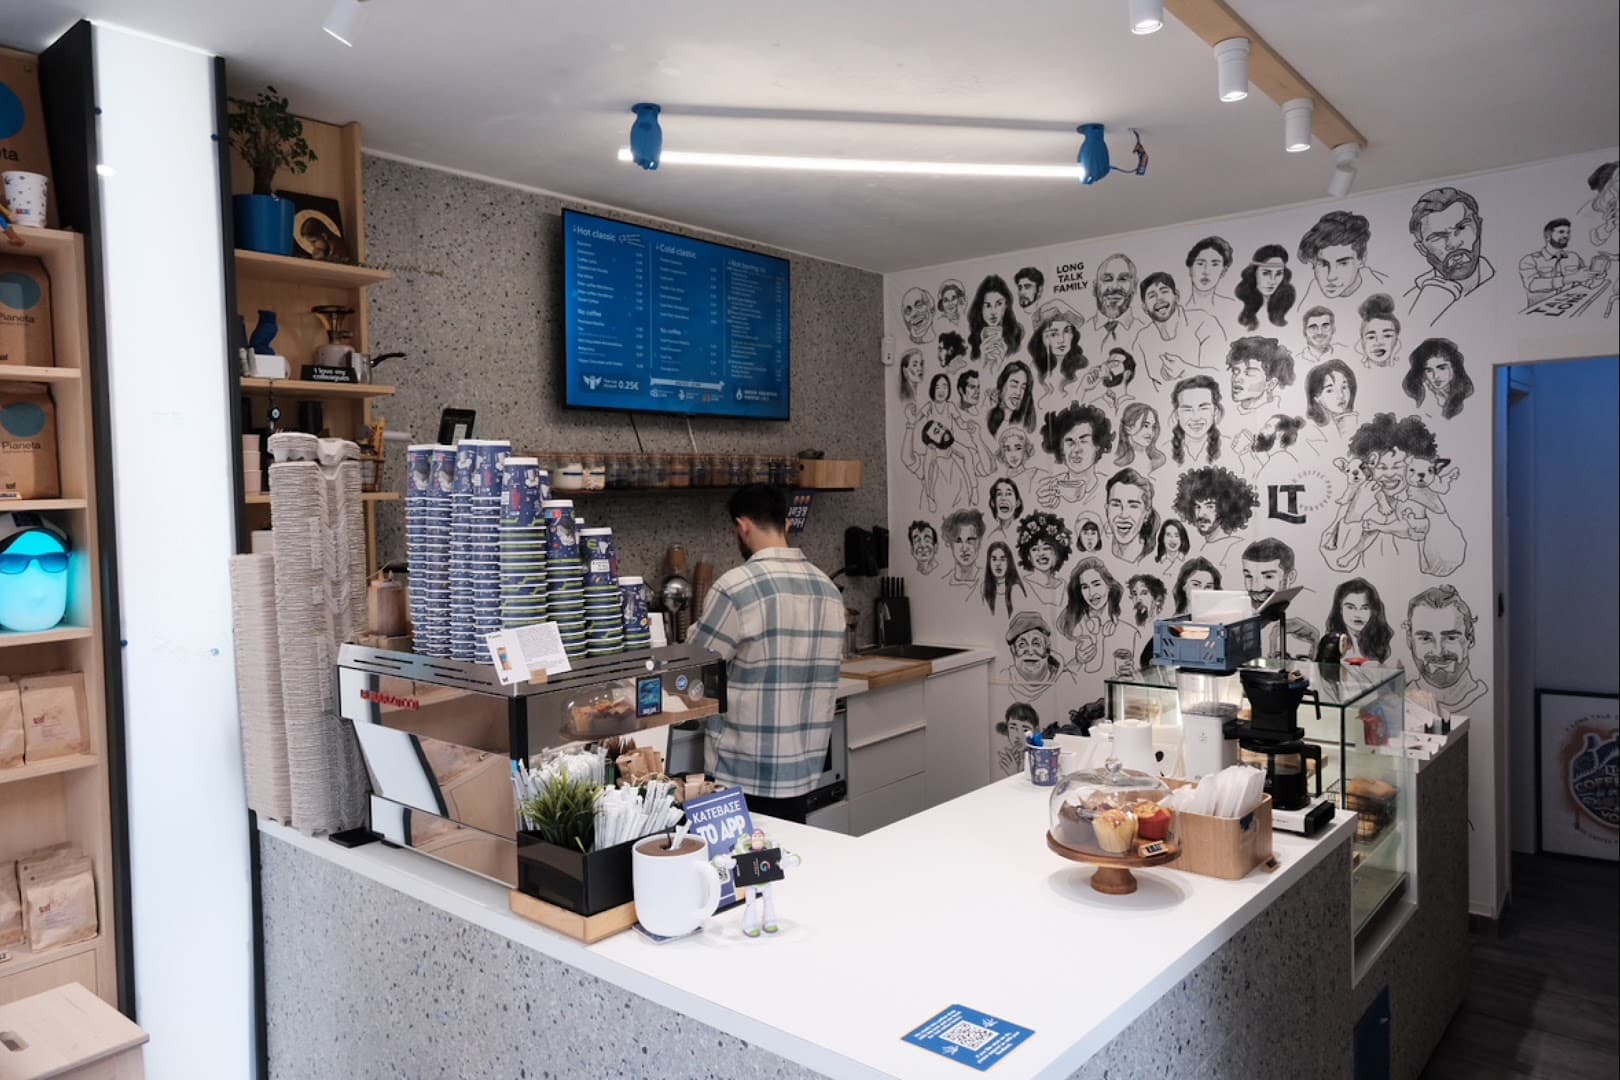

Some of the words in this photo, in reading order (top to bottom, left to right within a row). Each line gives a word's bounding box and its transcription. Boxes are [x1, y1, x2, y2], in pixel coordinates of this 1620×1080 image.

[1056, 261, 1084, 274] LONG
[1058, 271, 1083, 283] TALK
[1054, 281, 1088, 293] FAMILY
[2, 441, 41, 451] Pianeta
[692, 800, 742, 824] ΚΑΤΕΒΑΣΕ
